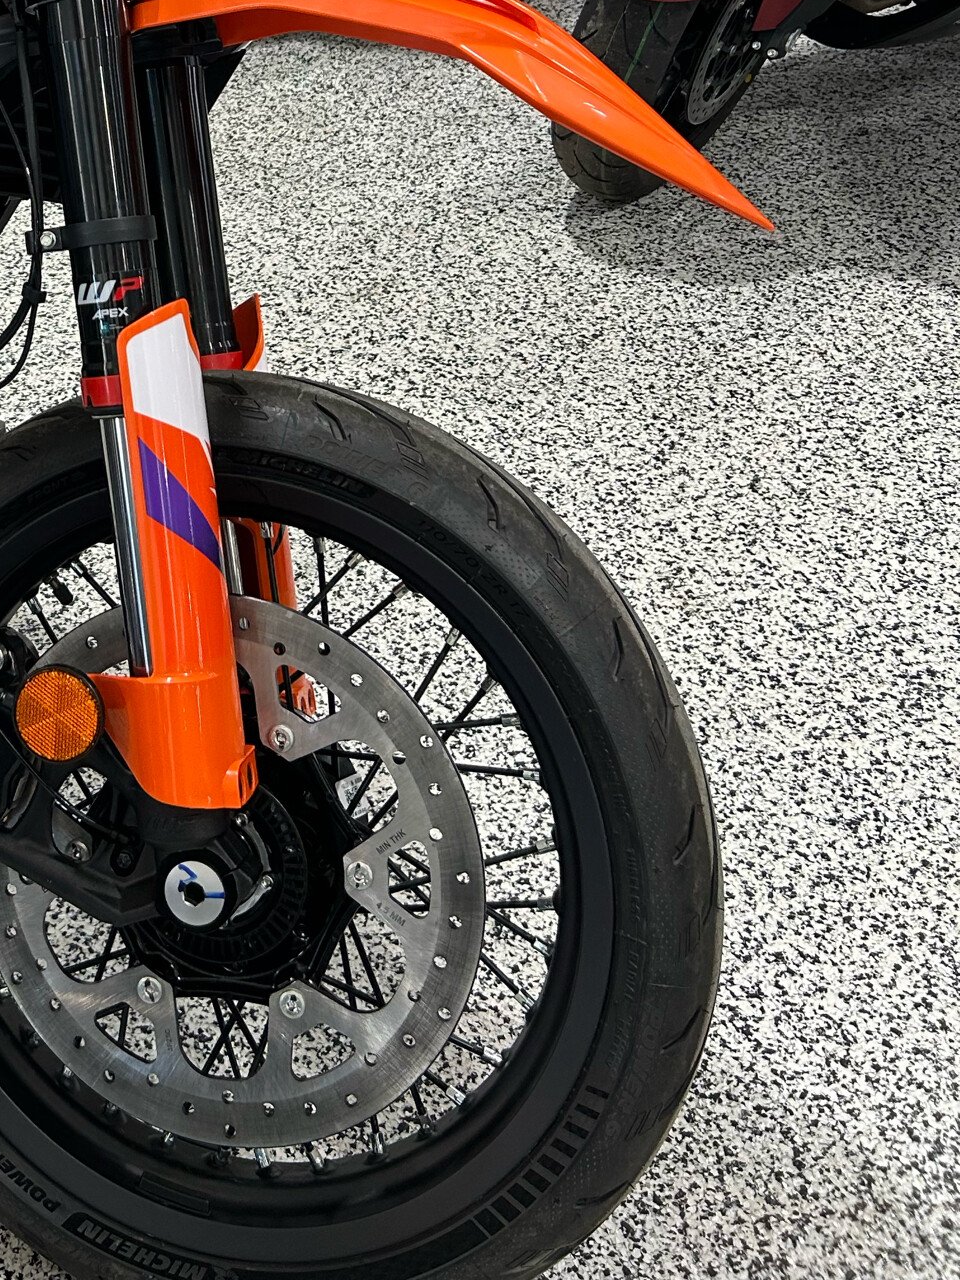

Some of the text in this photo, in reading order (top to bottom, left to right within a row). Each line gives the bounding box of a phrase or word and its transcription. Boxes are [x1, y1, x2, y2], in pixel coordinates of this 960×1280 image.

[77, 276, 145, 306] WP
[92, 306, 129, 320] APEX
[375, 828, 407, 855] MIN THK
[76, 1218, 210, 1280] MICHELIN
